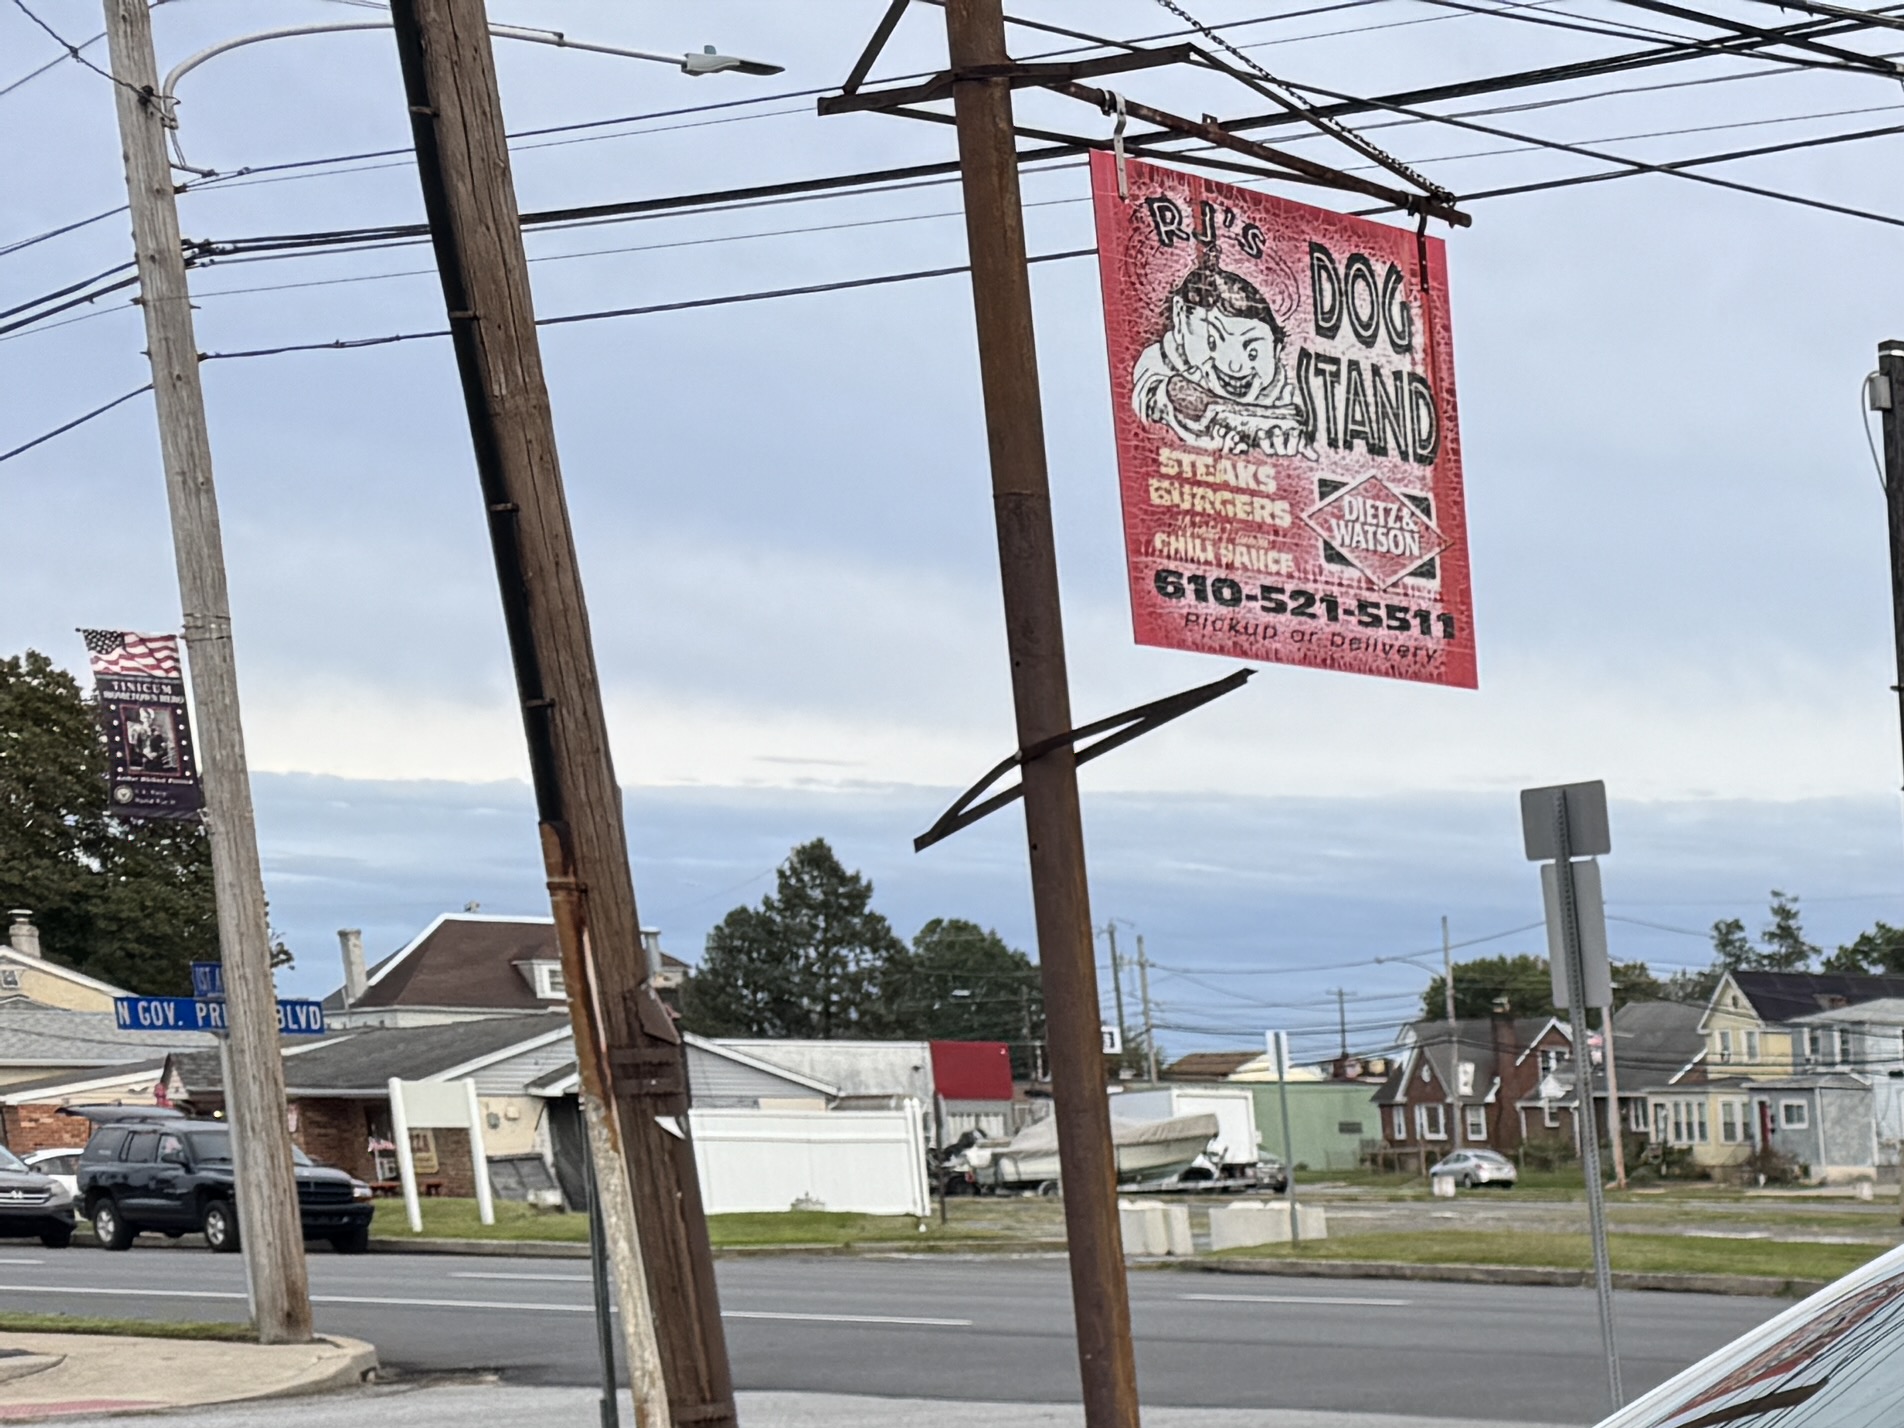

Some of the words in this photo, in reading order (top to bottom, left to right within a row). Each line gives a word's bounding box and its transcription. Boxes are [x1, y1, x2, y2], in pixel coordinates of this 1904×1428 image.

[1309, 240, 1414, 355] DOG
[1296, 346, 1441, 466] STAND
[1159, 447, 1277, 494] STEAKS
[1149, 477, 1292, 528] BURGERS
[1154, 531, 1216, 565] CHILI
[1330, 519, 1421, 557] WATSON
[1154, 568, 1456, 640] 610-521-5511
[1184, 611, 1278, 641] Pickup
[1290, 628, 1317, 644] or
[1330, 630, 1439, 663] Delivery
[111, 681, 172, 695] TINICUM
[116, 1001, 131, 1025] N
[137, 1001, 184, 1027] GOV.
[277, 1005, 321, 1030] BLVD
